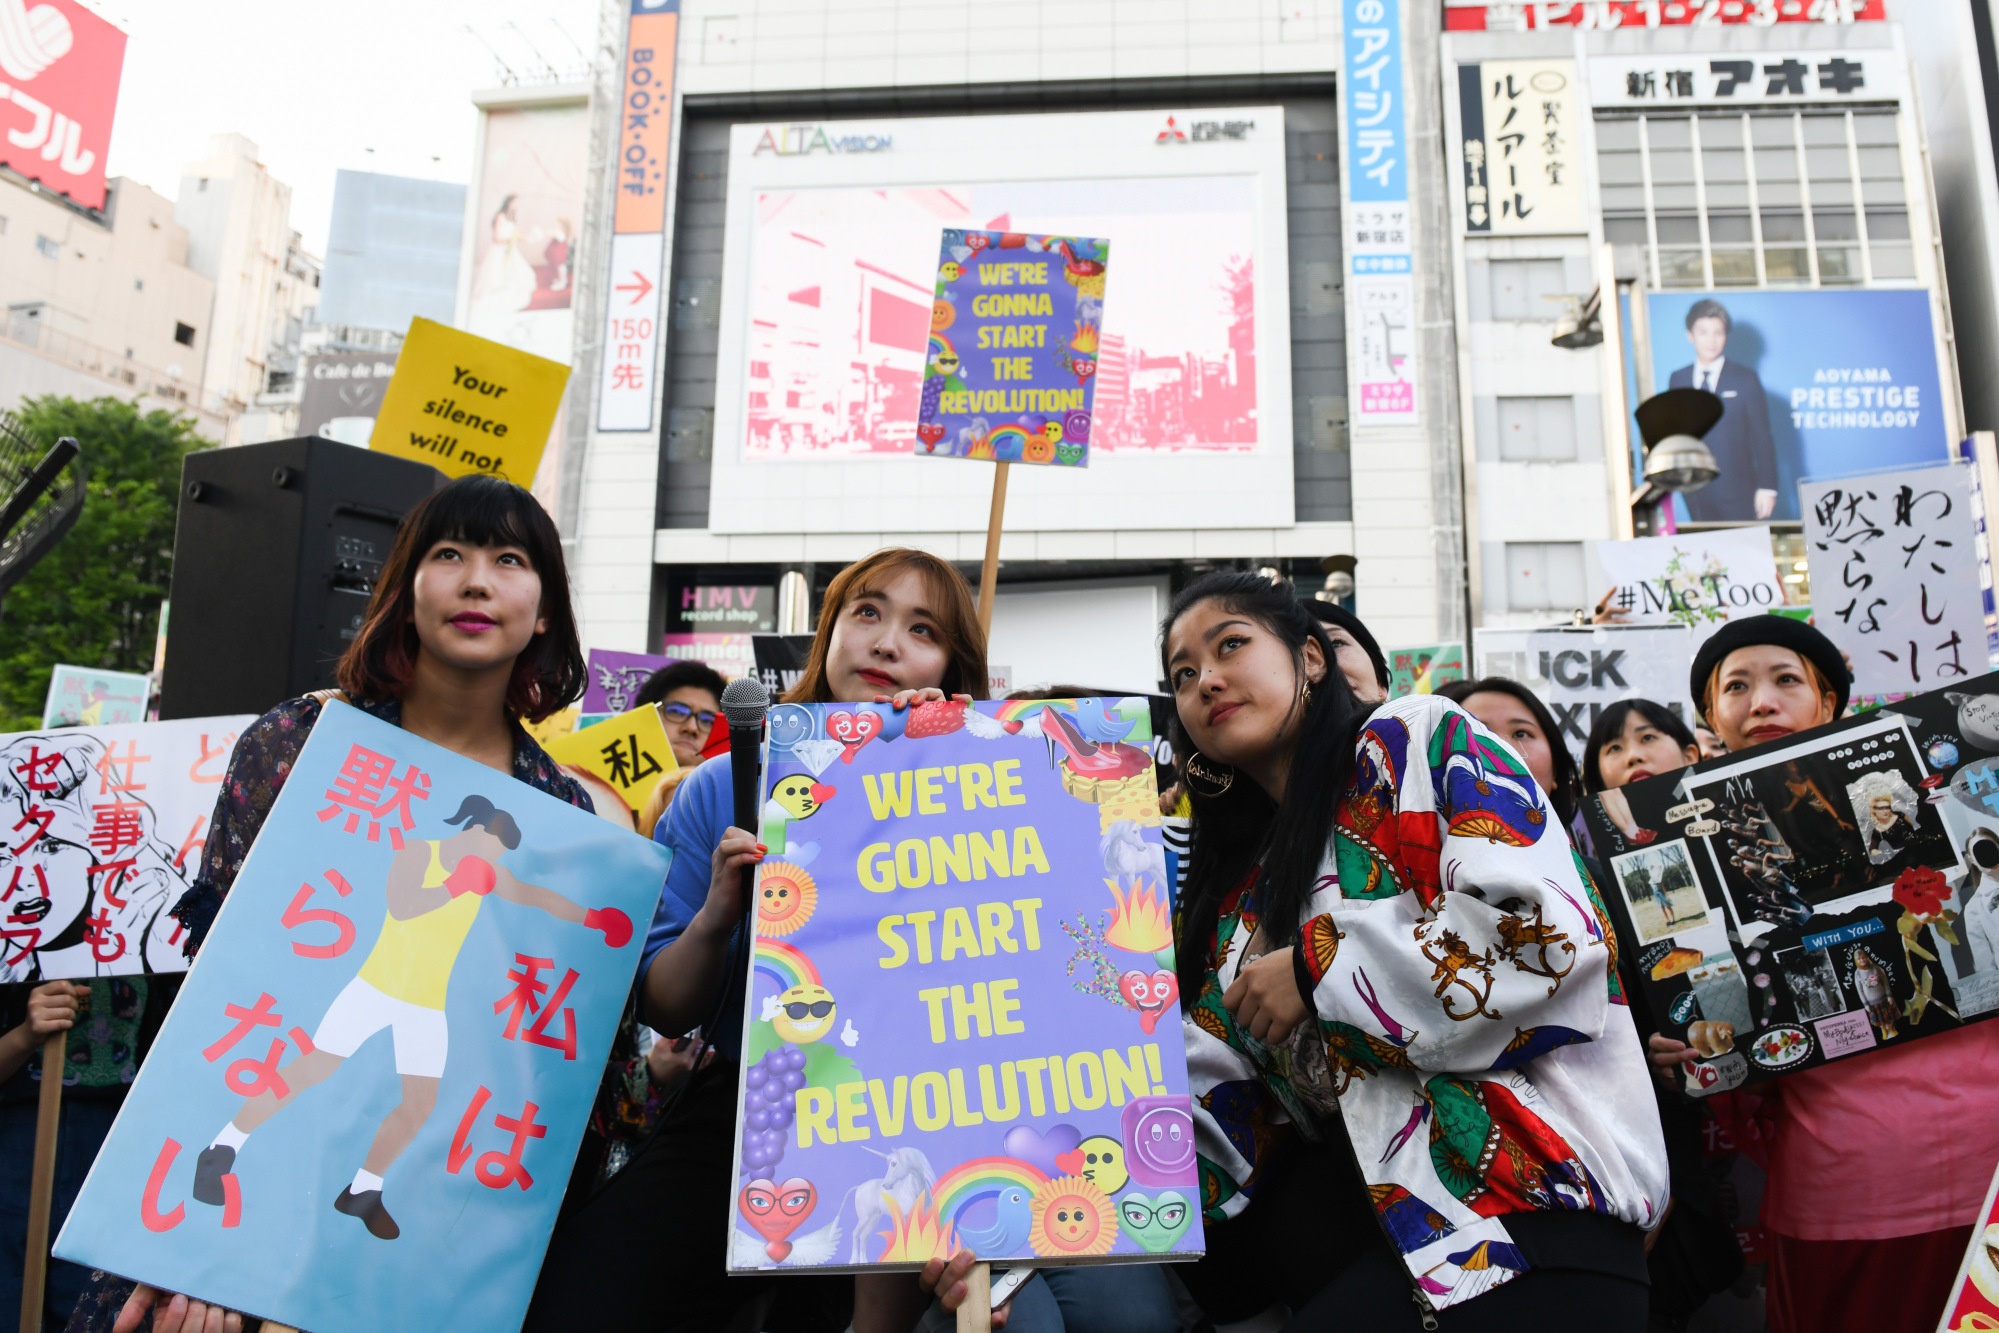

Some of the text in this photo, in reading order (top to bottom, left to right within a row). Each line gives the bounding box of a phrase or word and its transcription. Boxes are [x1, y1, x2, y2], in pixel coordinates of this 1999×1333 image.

[0, 82, 96, 176] フル
[752, 125, 832, 156] ALTA
[1494, 74, 1534, 220] ルノアール
[978, 262, 1048, 286] WE'RE
[971, 293, 1053, 317] GONNA
[977, 325, 1048, 349] START
[453, 365, 508, 399] Your
[991, 357, 1033, 381] THE
[1814, 367, 1893, 384] AOYAMA
[939, 388, 1085, 414] REVOLUTION!
[1790, 386, 1920, 409] PRESTIGE
[423, 398, 509, 438] silence
[1790, 410, 1920, 429] TECHNOLOGY
[409, 432, 504, 474] will not
[1617, 574, 1774, 615] #MeToo
[1893, 485, 1968, 683] わたしは
[680, 609, 759, 624] record shop
[1485, 650, 1628, 688] FUCK
[601, 734, 663, 789] 私
[863, 759, 1026, 821] WE'RE
[1668, 801, 1708, 820] Message
[1687, 822, 1718, 836] Board
[0, 746, 64, 967] セクハラ
[83, 739, 152, 963] 仕事でも
[856, 826, 1050, 893] GONNA
[877, 898, 1043, 969] START
[1811, 931, 1842, 948] WITH
[140, 743, 432, 1233] 黙らない
[918, 978, 1025, 1044] THE
[446, 952, 581, 1193] 私は
[795, 1044, 1167, 1149] REVOLUTION!
